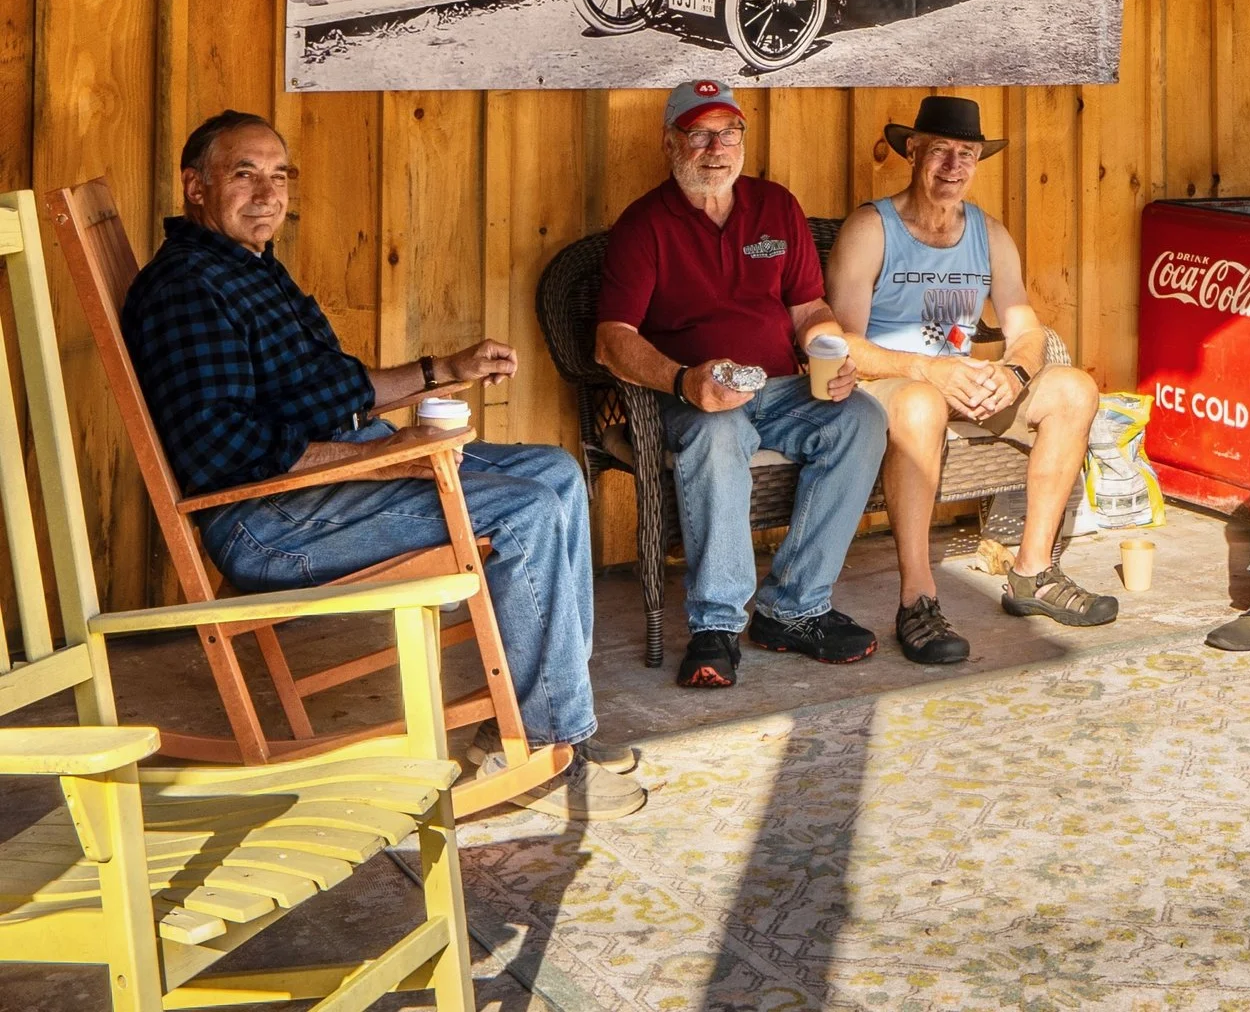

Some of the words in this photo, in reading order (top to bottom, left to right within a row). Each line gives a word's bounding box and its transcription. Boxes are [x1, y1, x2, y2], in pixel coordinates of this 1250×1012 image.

[699, 84, 717, 92] 41
[1177, 252, 1210, 265] DRINK
[892, 271, 992, 286] CORVETTE
[921, 288, 979, 324] SHOW
[1155, 382, 1186, 414] ICE
[1191, 392, 1249, 429] COLD
